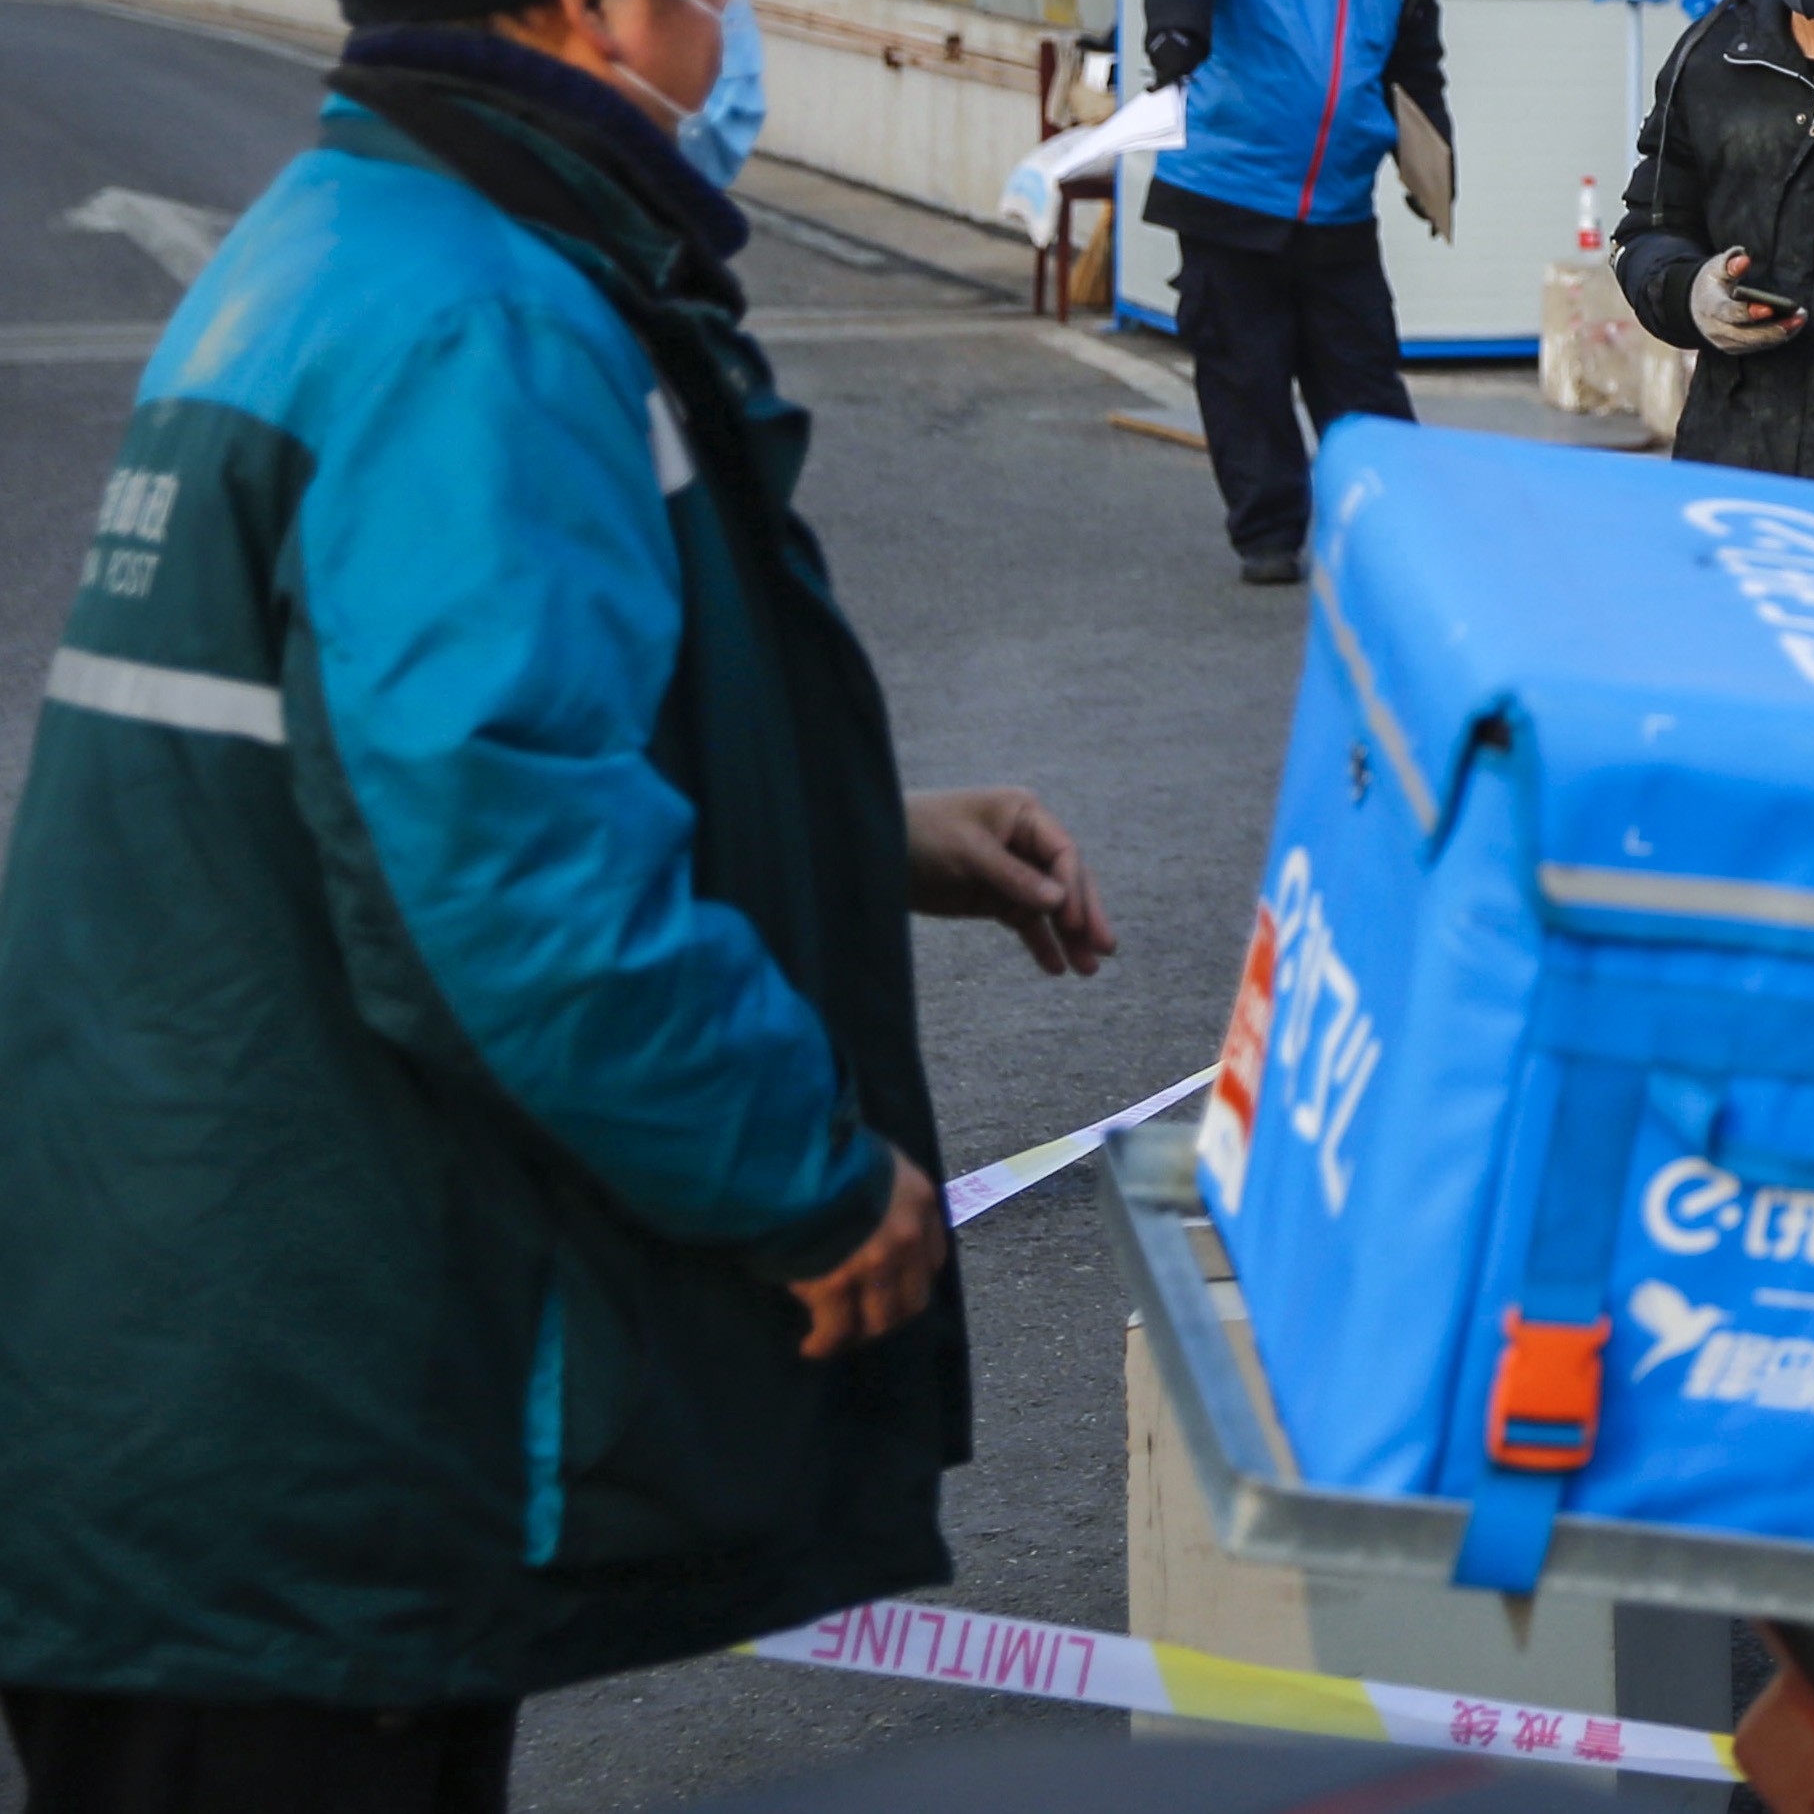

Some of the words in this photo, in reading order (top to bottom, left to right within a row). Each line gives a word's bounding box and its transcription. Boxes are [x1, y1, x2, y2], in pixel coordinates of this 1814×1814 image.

[811, 1603, 1096, 1698] LIMITLINE
[1450, 1700, 1625, 1763] 警戒线
